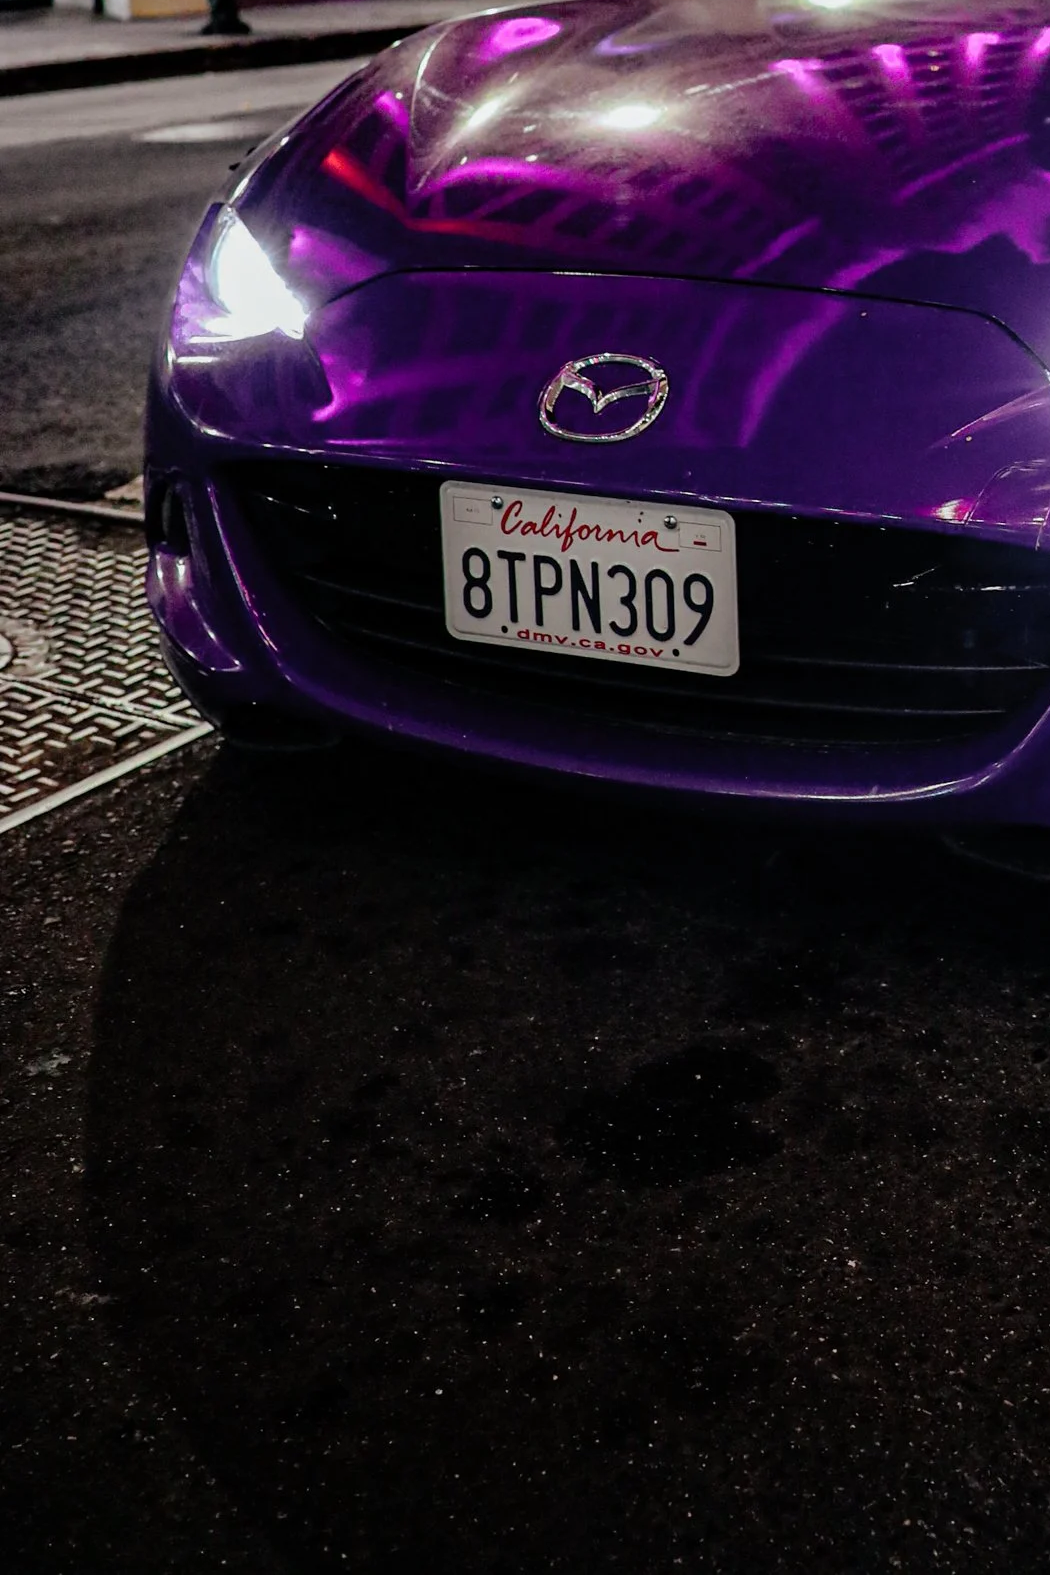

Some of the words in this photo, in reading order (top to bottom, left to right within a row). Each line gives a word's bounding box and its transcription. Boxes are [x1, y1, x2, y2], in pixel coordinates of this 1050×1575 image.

[501, 500, 680, 552] California
[462, 547, 714, 645] 8TPN309
[517, 628, 664, 658] dmv.ca.gov
